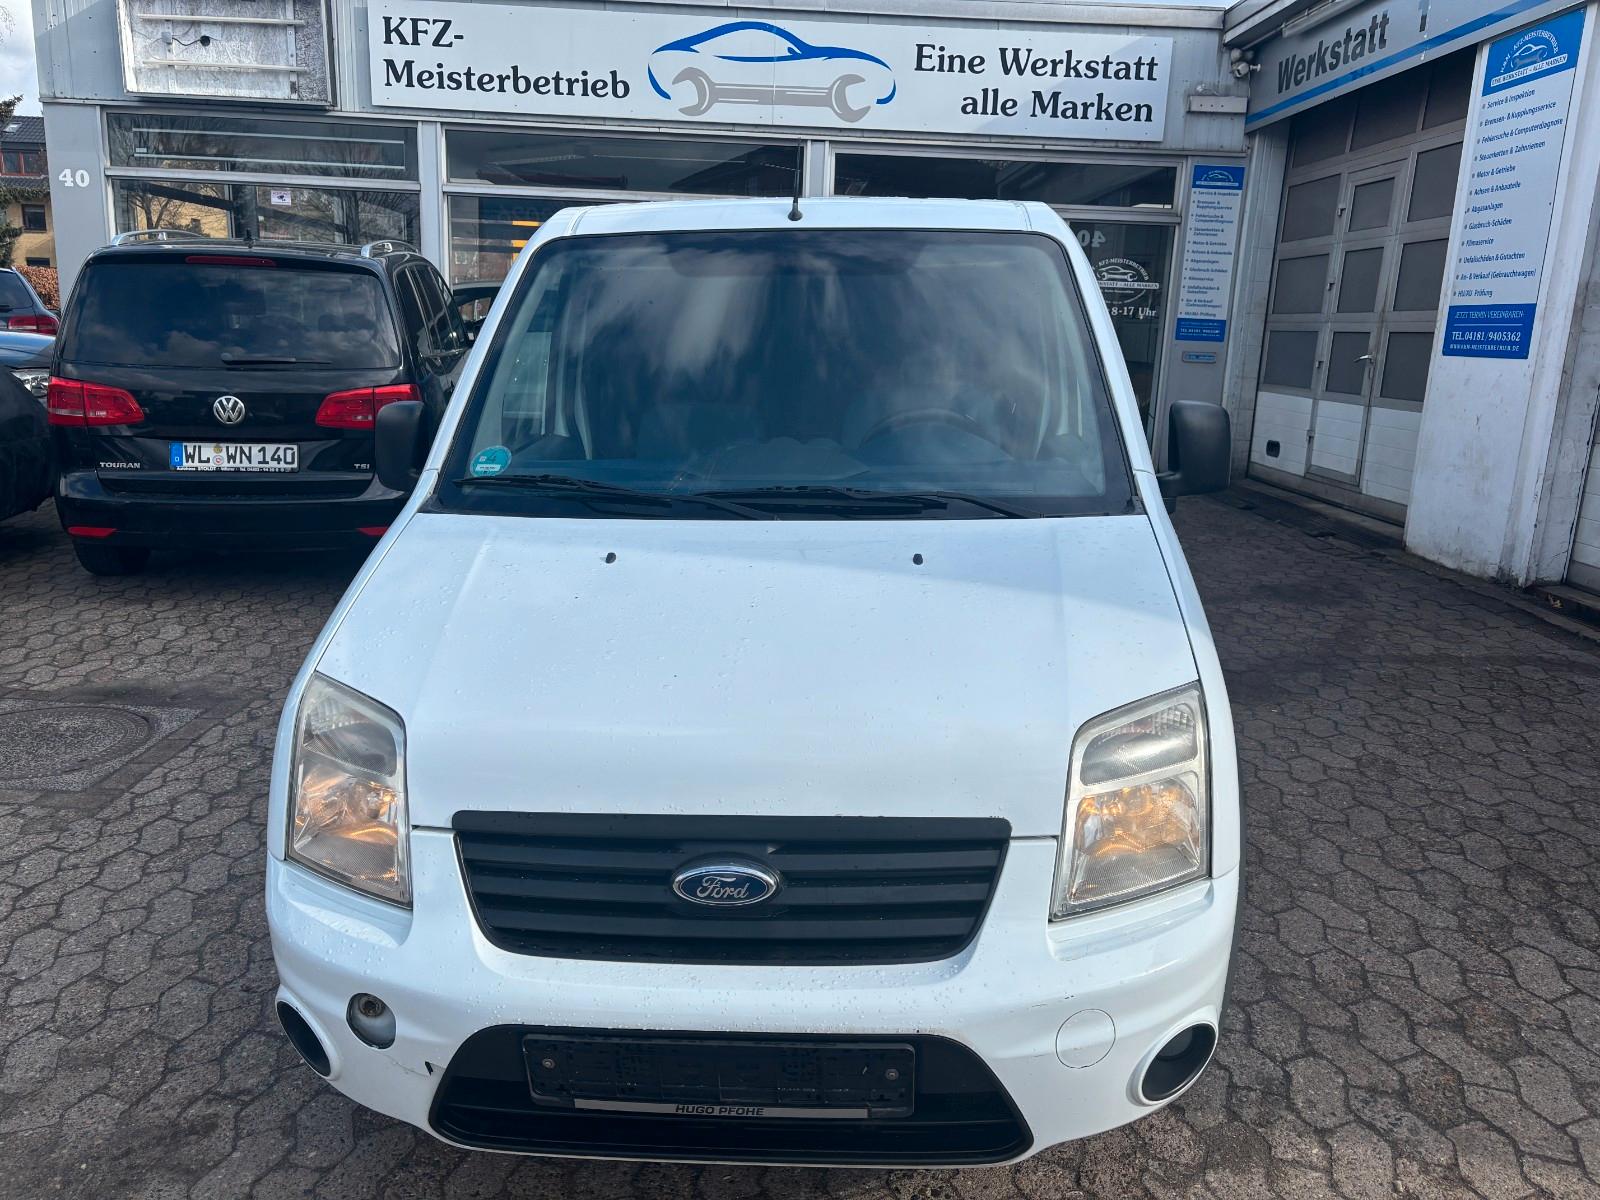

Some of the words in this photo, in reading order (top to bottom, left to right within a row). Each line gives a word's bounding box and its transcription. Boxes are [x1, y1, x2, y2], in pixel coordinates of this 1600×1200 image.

[382, 15, 464, 48] KFZ-
[914, 43, 986, 75] Eine
[998, 47, 1159, 82] Werkstatt
[1277, 11, 1390, 94] Werkstatt
[383, 58, 630, 99] Meisterbetrieb
[960, 87, 1018, 117] alle
[1029, 90, 1153, 123] Marken
[58, 168, 90, 188] 40
[1138, 307, 1157, 317] Uhr
[99, 461, 141, 469] TOURAN
[183, 444, 211, 464] WL
[225, 445, 252, 465] WN
[257, 446, 296, 466] 140
[695, 875, 751, 899] Ford
[674, 1103, 715, 1115] HUGO
[718, 1106, 765, 1116] PFOHE
